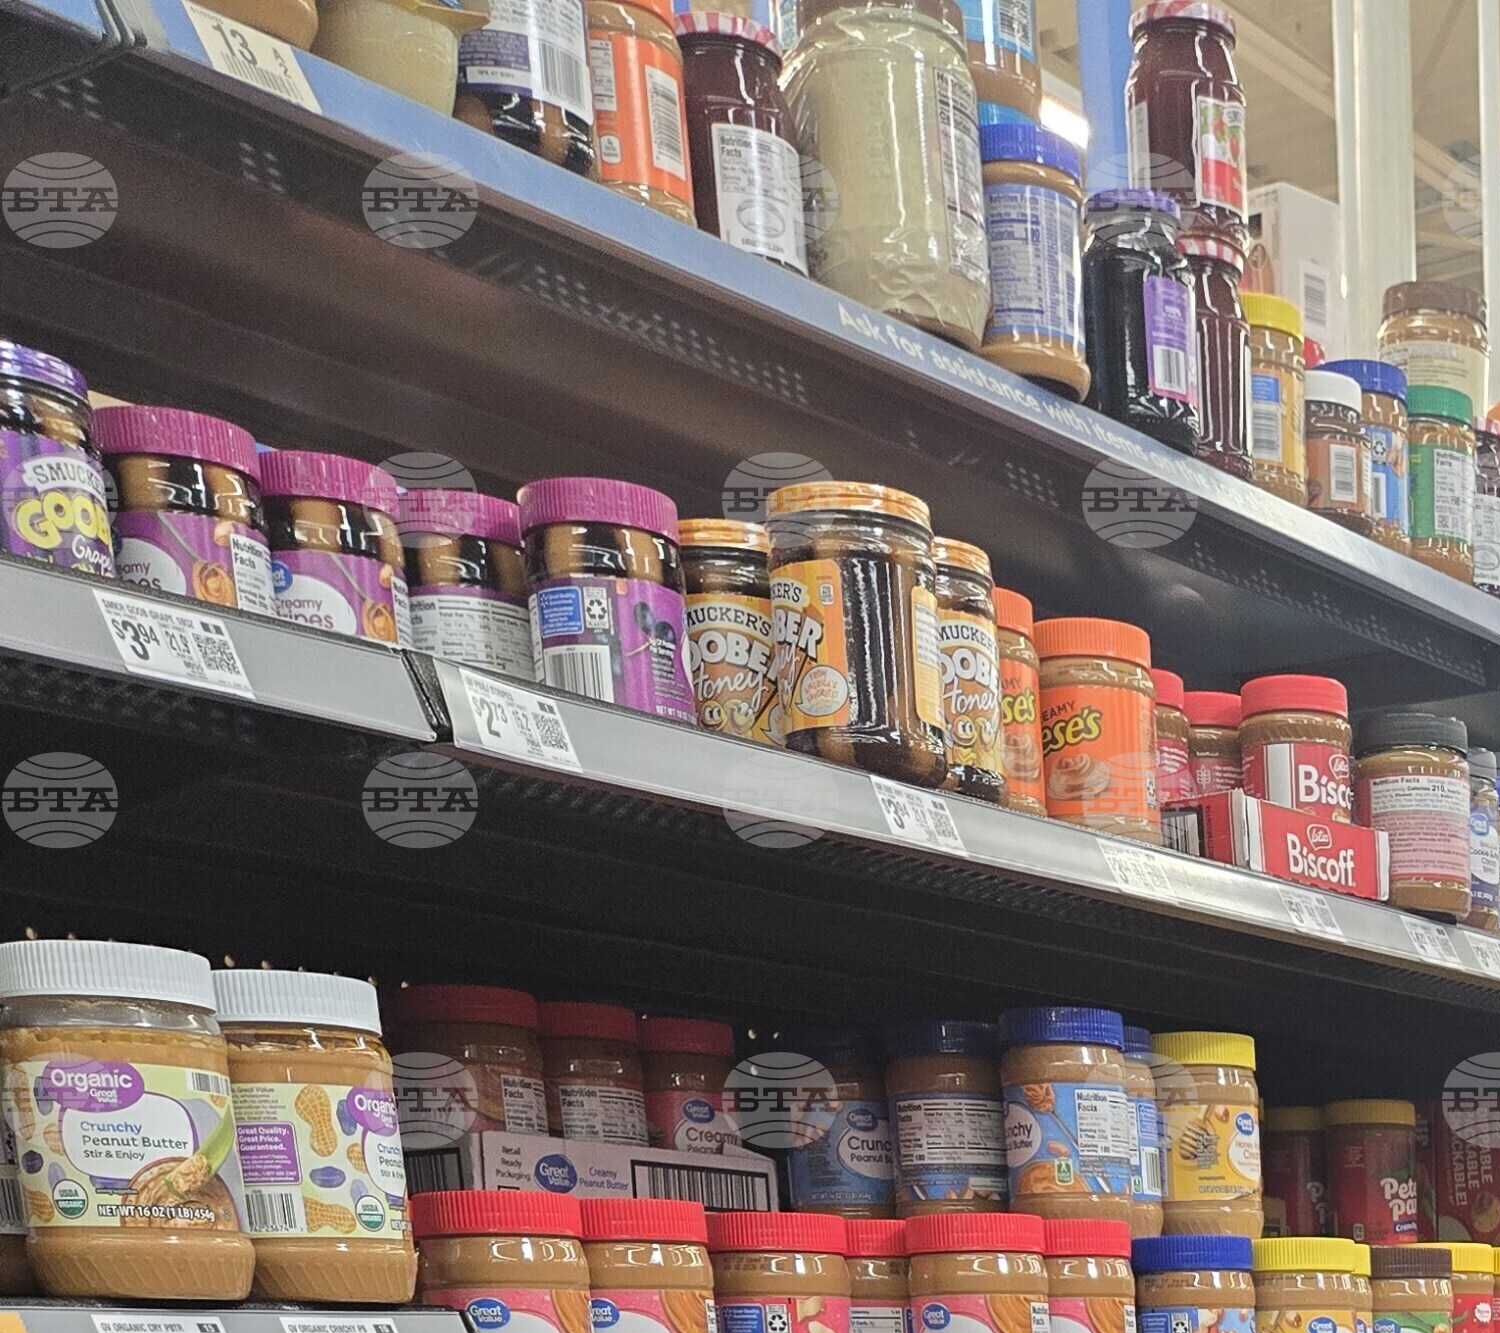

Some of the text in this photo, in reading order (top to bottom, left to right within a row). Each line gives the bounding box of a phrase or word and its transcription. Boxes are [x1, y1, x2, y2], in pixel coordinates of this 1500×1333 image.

[837, 302, 880, 344] Ask
[884, 323, 925, 362] for
[931, 345, 1038, 412] assistance
[1286, 833, 1354, 886] Biscoff
[50, 1069, 133, 1092] Organic
[1077, 1091, 1107, 1102] Nutrition
[1077, 1102, 1098, 1113] Facts
[80, 1121, 142, 1141] Crunchy
[82, 1135, 188, 1150] Peanut Butter
[239, 1136, 256, 1144] Great
[84, 1150, 145, 1161] Stir & Enjoy
[98, 1205, 117, 1216] NET
[120, 1205, 136, 1217] WT
[137, 1206, 150, 1217] 16
[151, 1206, 165, 1218] OZ
[469, 1302, 502, 1320] Great
